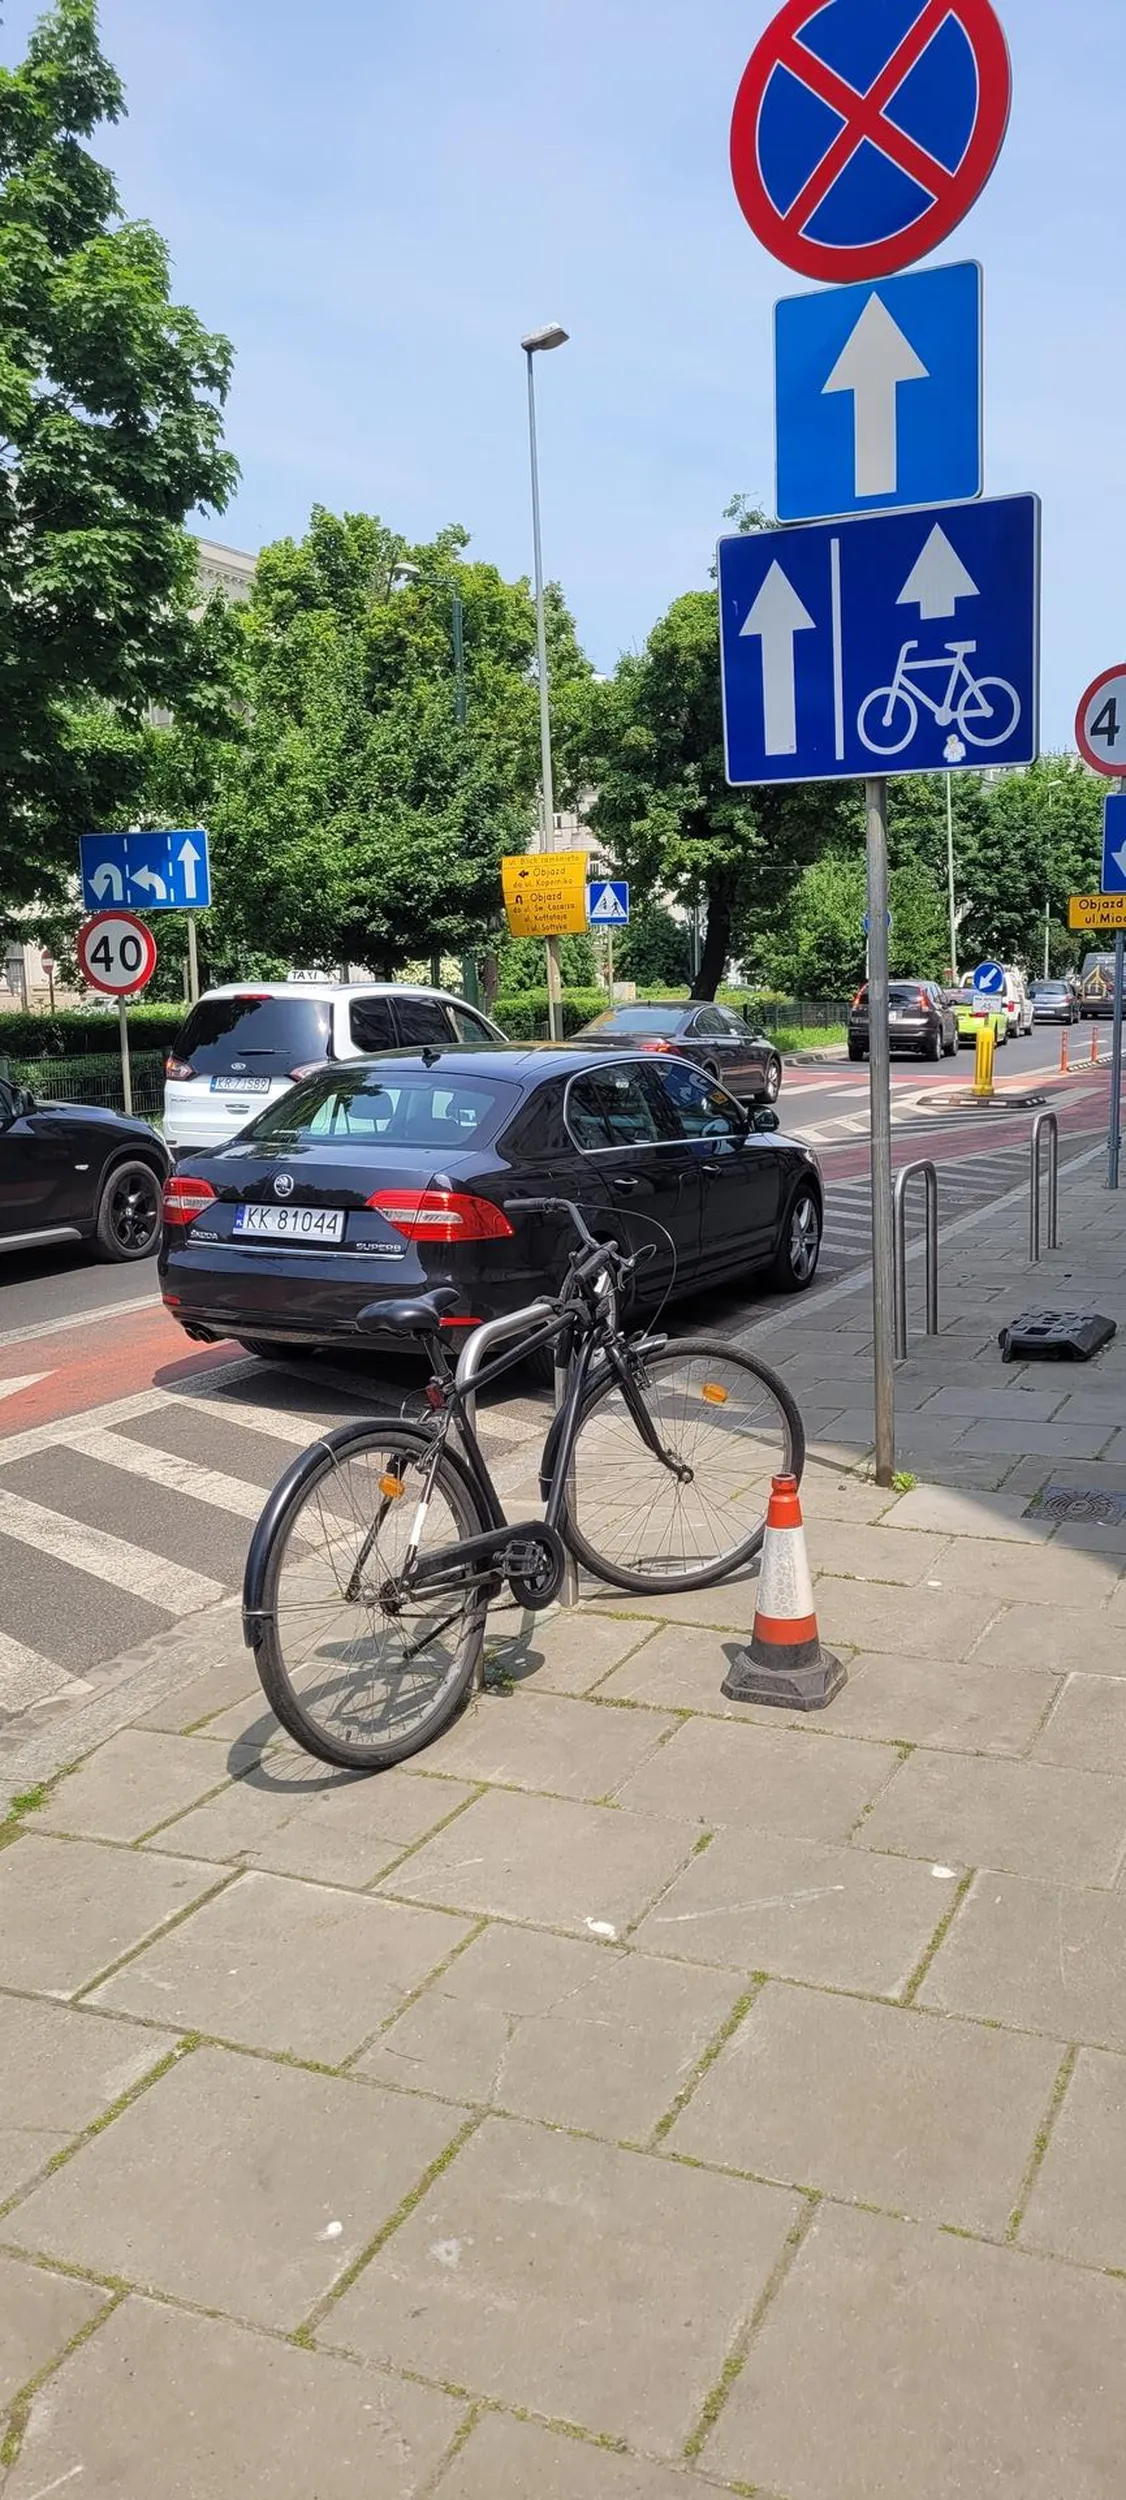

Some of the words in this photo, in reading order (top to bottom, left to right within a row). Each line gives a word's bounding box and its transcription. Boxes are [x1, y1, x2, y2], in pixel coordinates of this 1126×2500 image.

[533, 868, 565, 878] Objazd
[530, 892, 562, 902] Objazd
[513, 906, 522, 914] do
[1079, 898, 1124, 913] Objazd
[90, 935, 143, 973] 40
[292, 970, 318, 980] TAXI
[217, 1077, 232, 1088] KR
[247, 1207, 272, 1230] KK
[277, 1209, 338, 1235] 81044
[356, 1242, 402, 1253] SUPERB
